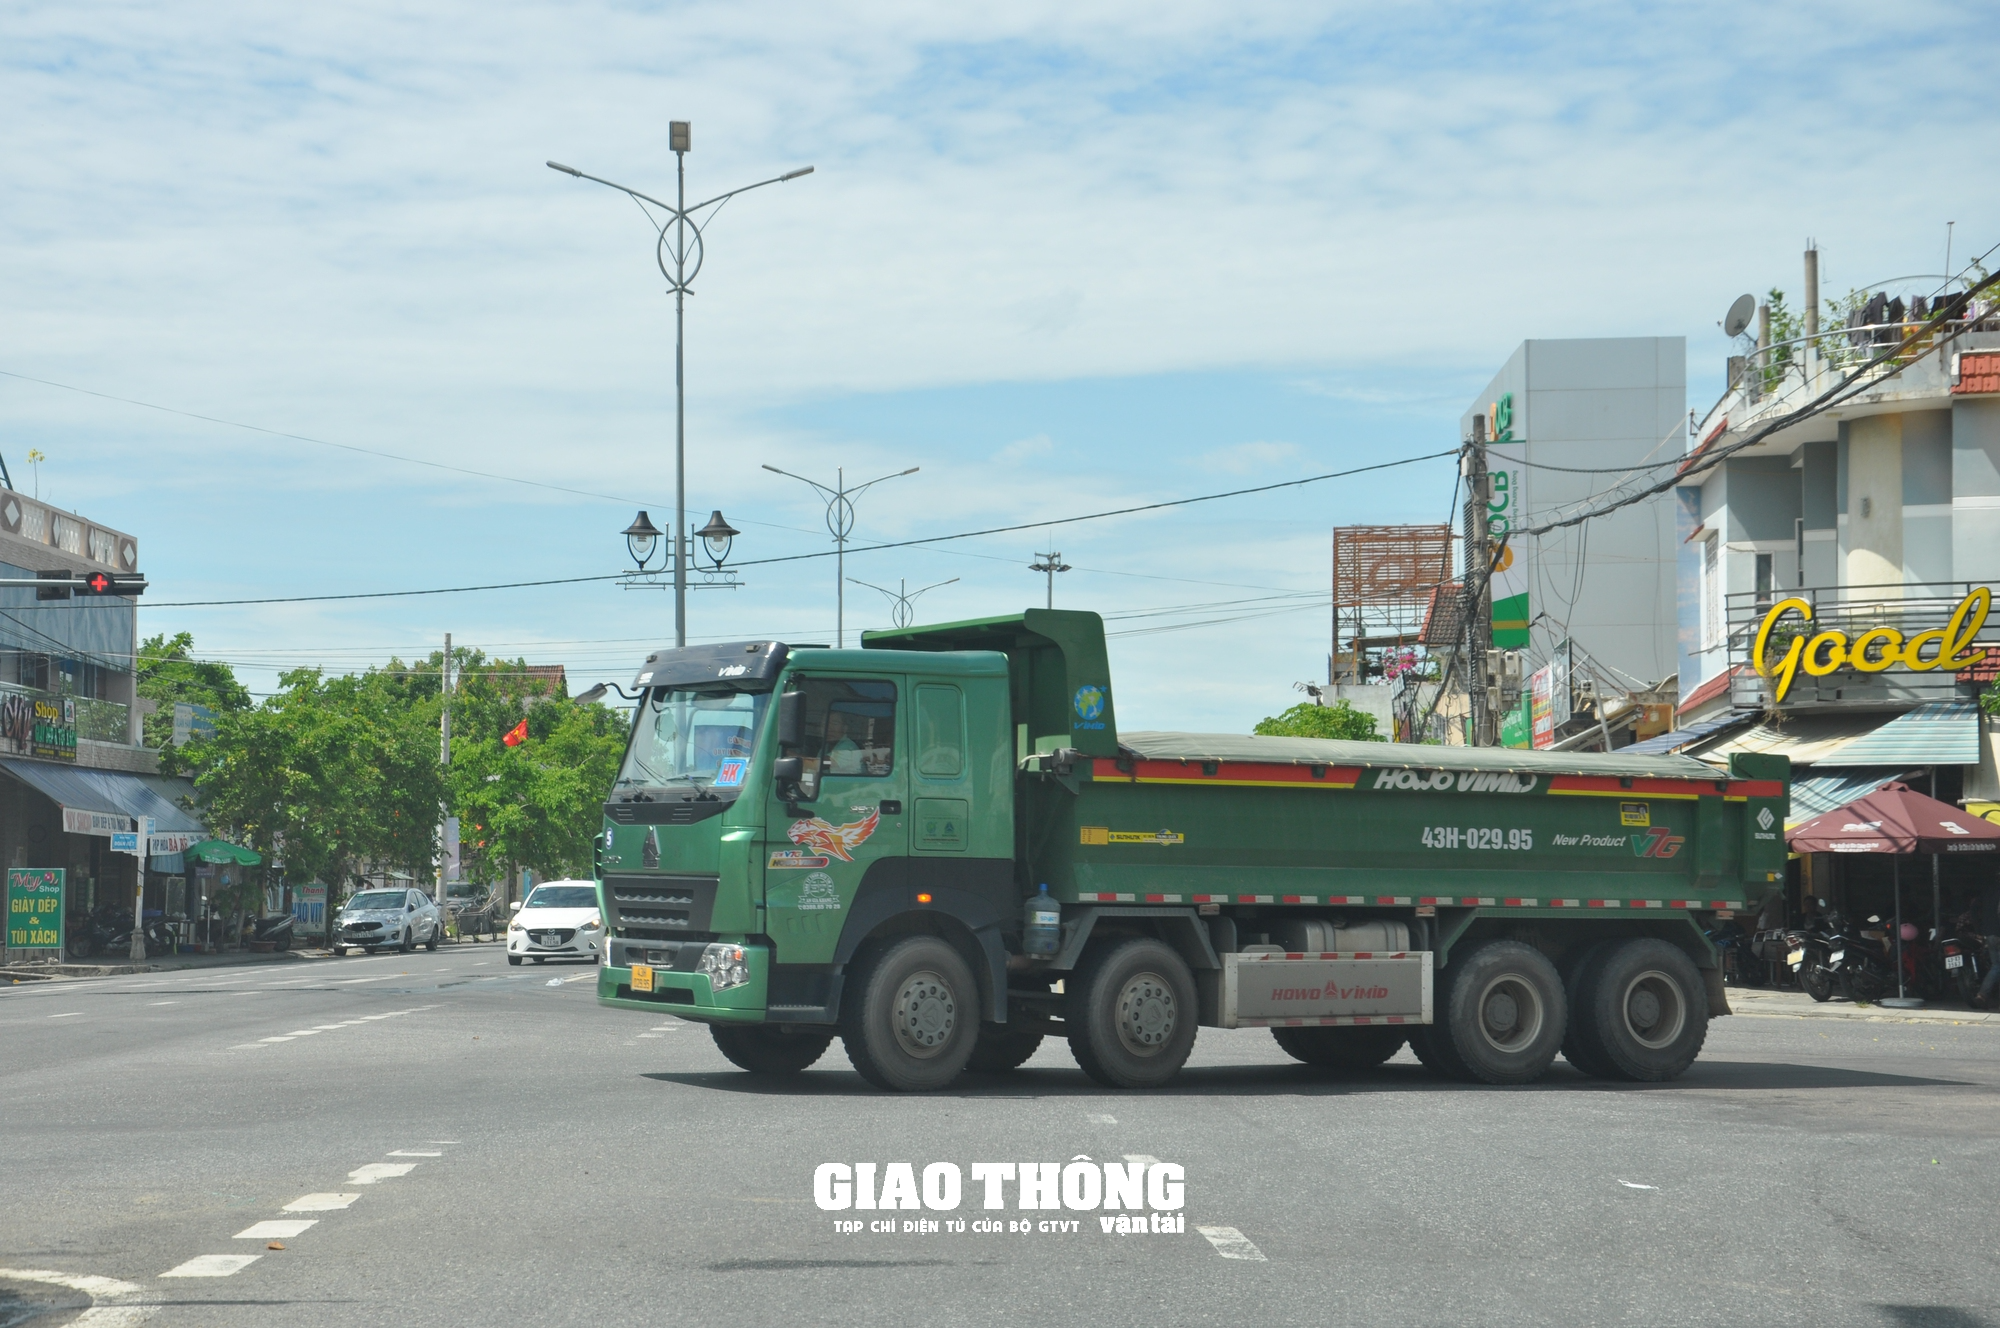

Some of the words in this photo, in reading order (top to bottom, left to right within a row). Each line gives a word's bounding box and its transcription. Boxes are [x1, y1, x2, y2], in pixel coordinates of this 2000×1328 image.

[1753, 586, 1992, 703] Good
[35, 701, 58, 723] Shop
[718, 762, 742, 783] HK
[606, 829, 612, 845] 5
[1422, 827, 1533, 850] 43H-029.95
[1552, 834, 1579, 846] New
[1580, 834, 1627, 847] Product
[10, 872, 42, 892] My
[39, 885, 60, 894] Shop
[11, 896, 35, 913] GIÀY
[38, 896, 58, 913] DÉP
[29, 916, 40, 925] &
[11, 927, 27, 944] TÚI
[30, 927, 58, 944] XÁCH
[1271, 988, 1321, 1000] HOWO
